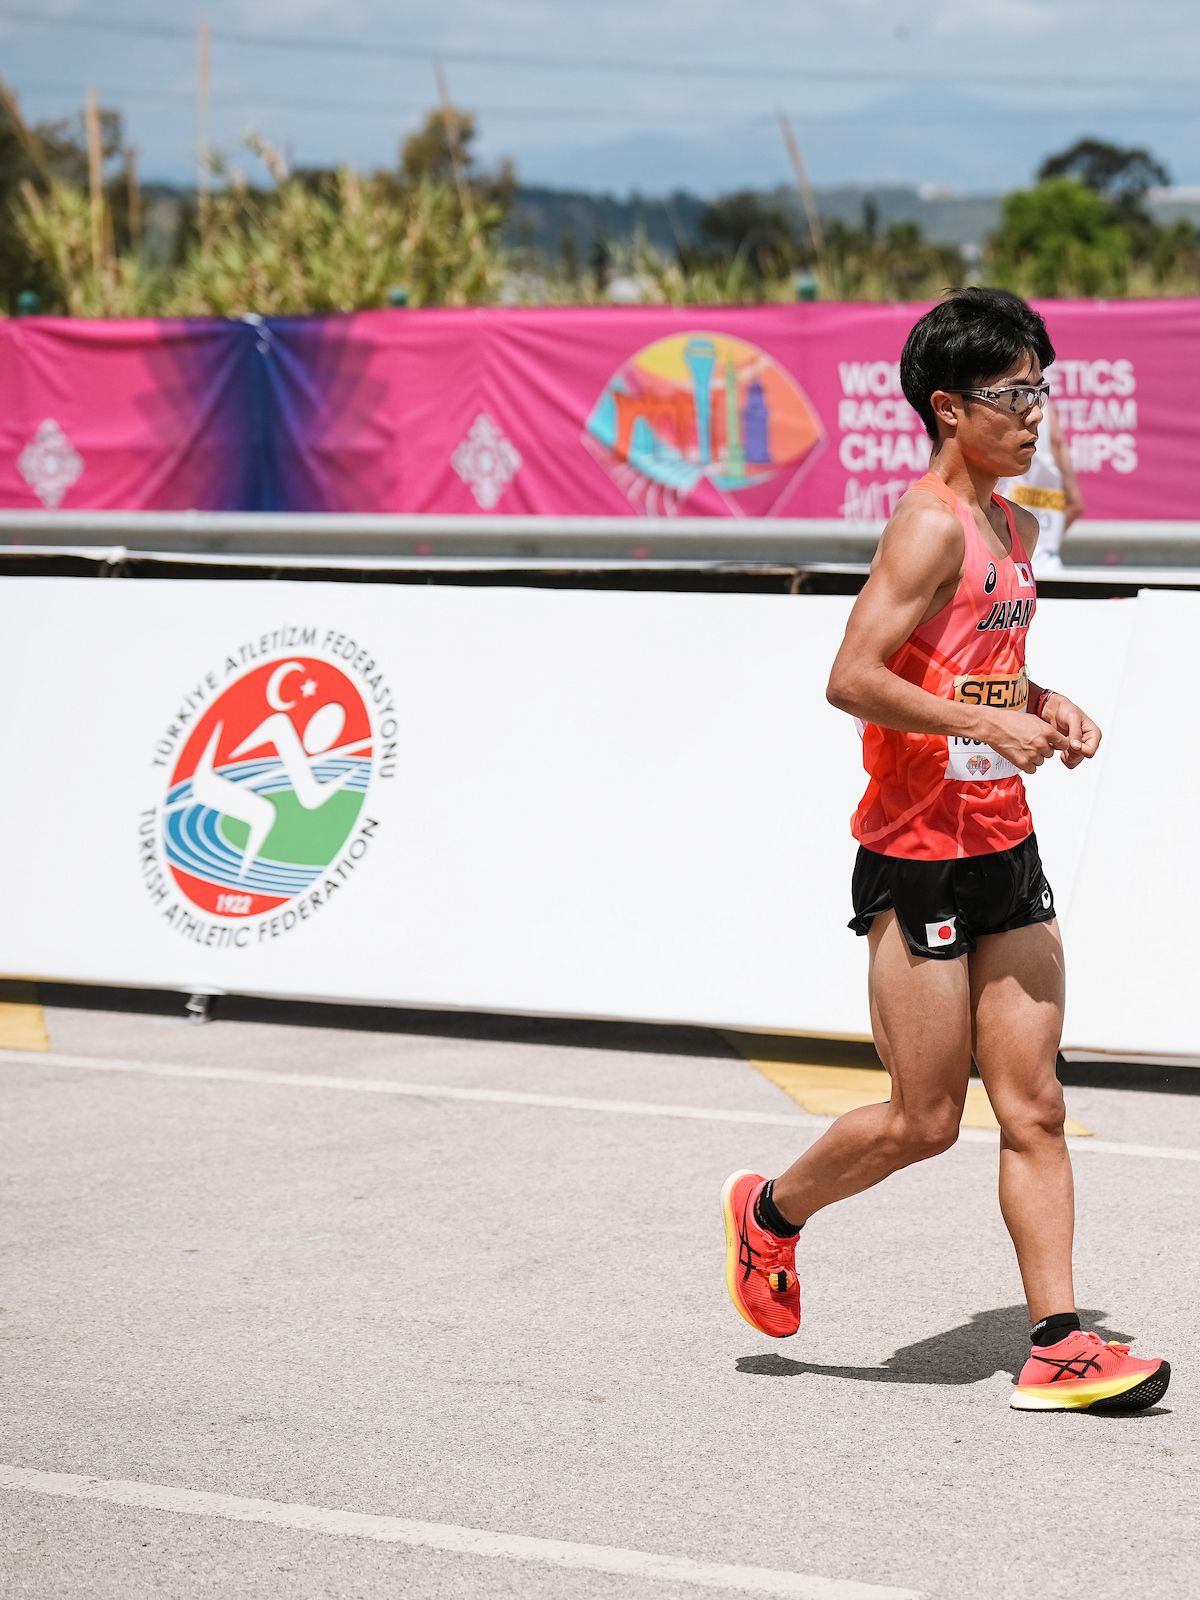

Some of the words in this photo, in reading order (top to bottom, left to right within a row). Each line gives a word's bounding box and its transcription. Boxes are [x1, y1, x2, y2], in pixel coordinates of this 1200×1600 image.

[838, 400, 916, 431] RACE
[1054, 398, 1138, 429] TEAM
[164, 902, 251, 950] ATHLETIC
[257, 816, 380, 943] FEDERATION
